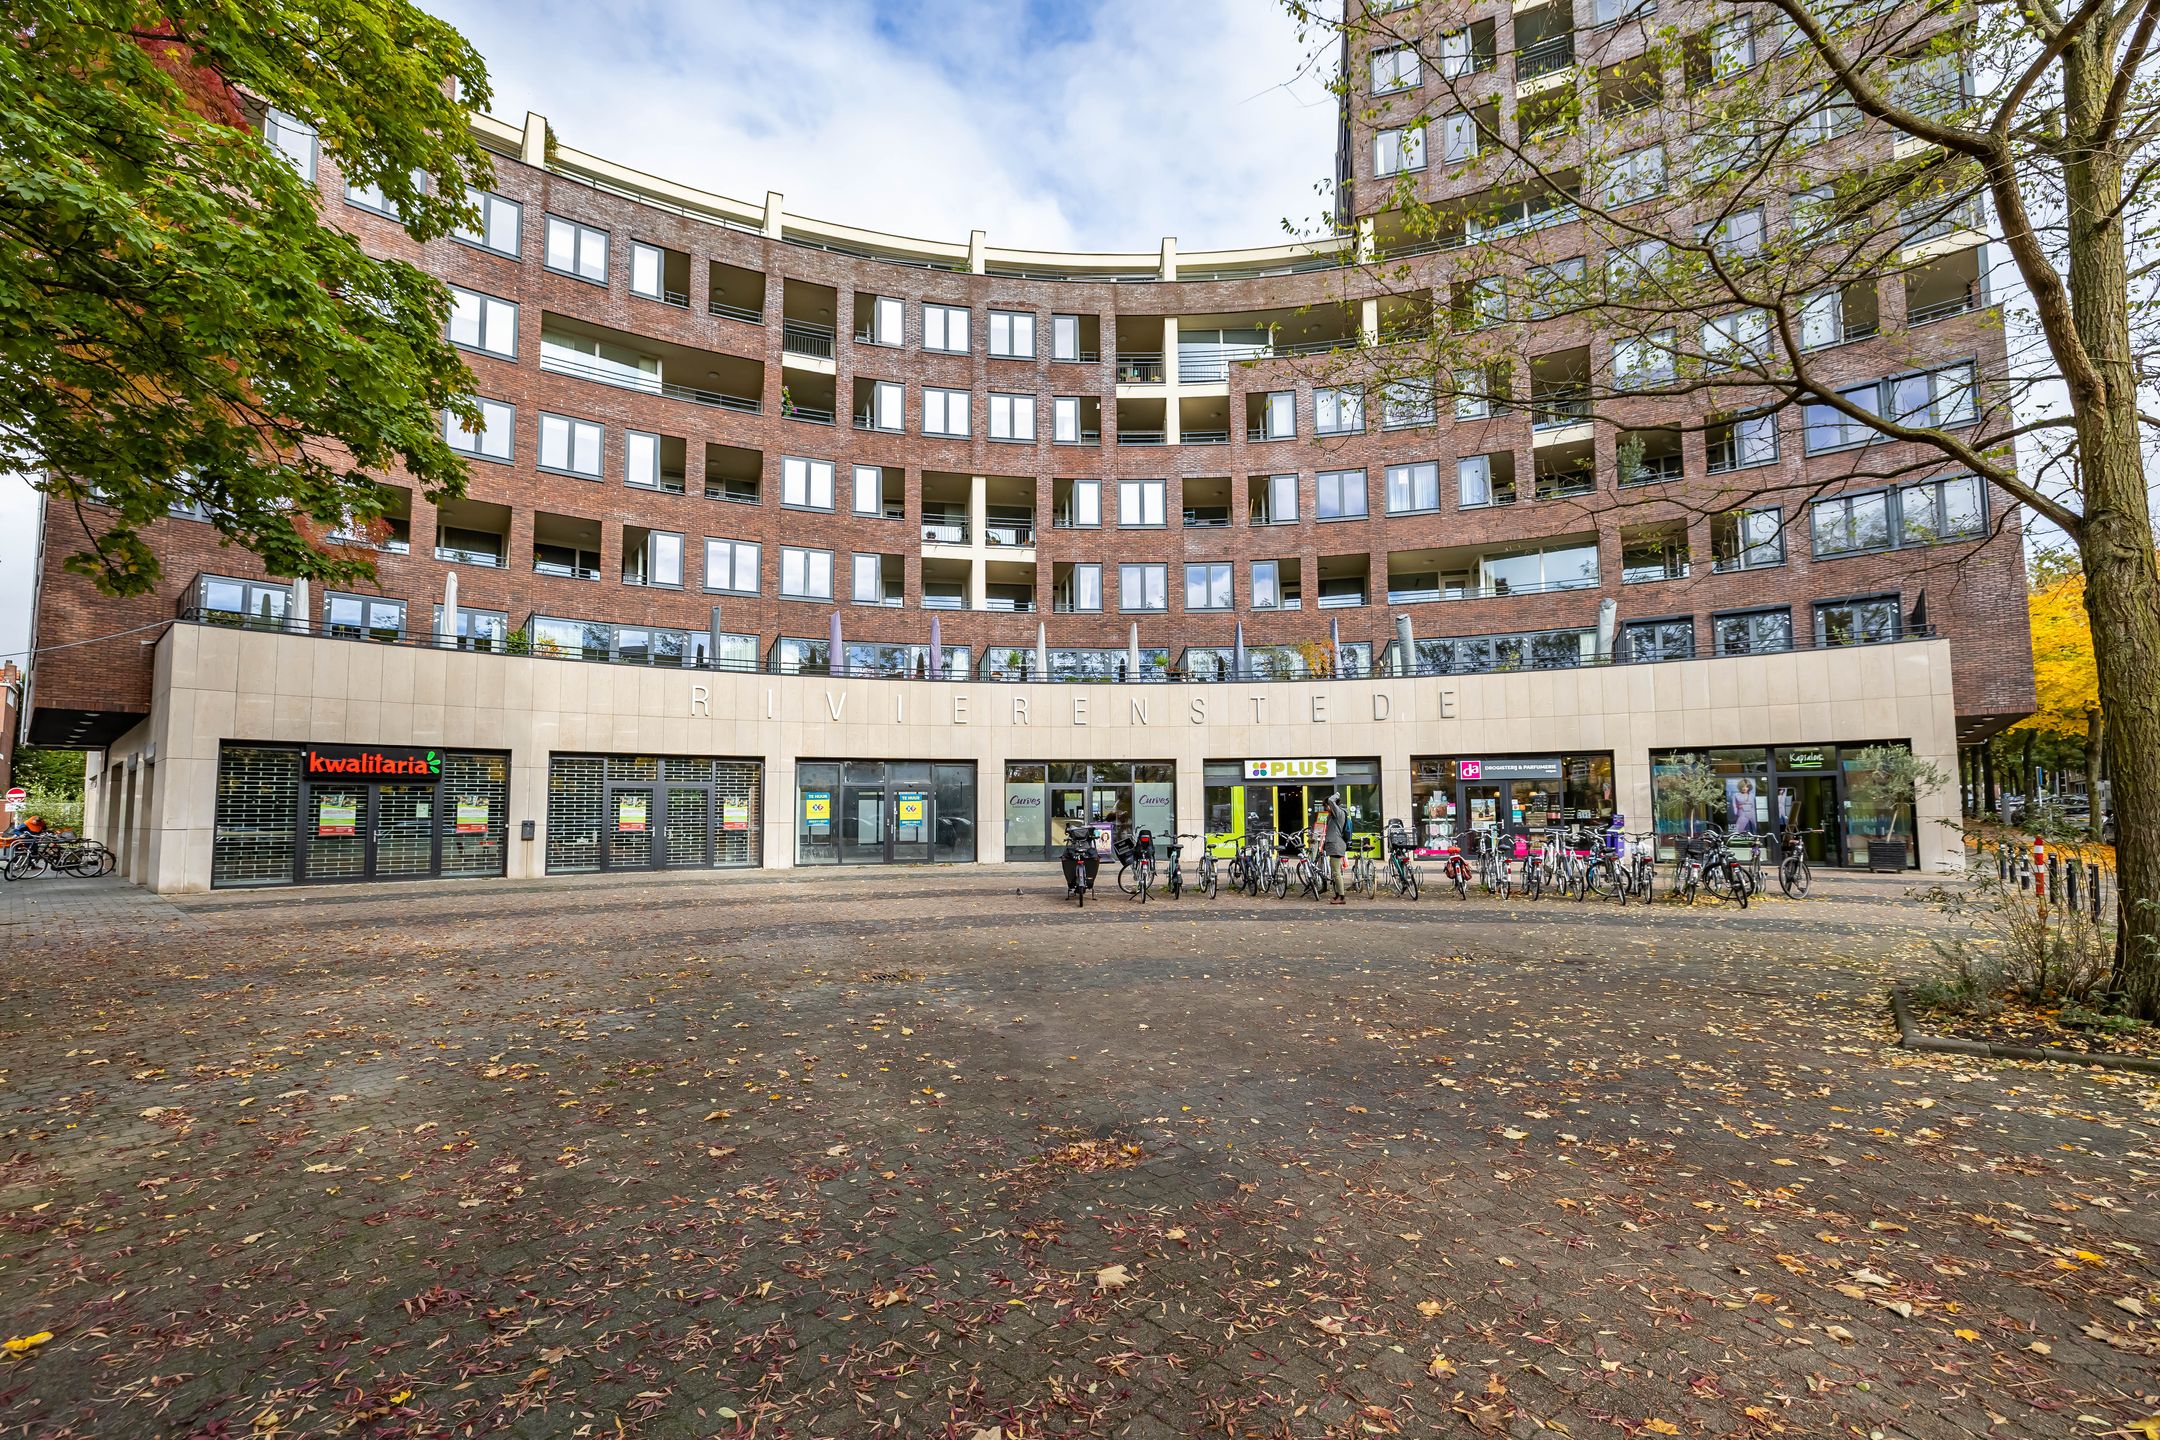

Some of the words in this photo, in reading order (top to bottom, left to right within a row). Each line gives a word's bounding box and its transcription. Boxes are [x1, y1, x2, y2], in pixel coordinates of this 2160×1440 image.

[309, 751, 427, 774] kwalitaria
[1270, 761, 1329, 776] PLUS
[1462, 763, 1479, 776] da
[1010, 795, 1041, 806] Curves
[1139, 794, 1170, 805] Curves
